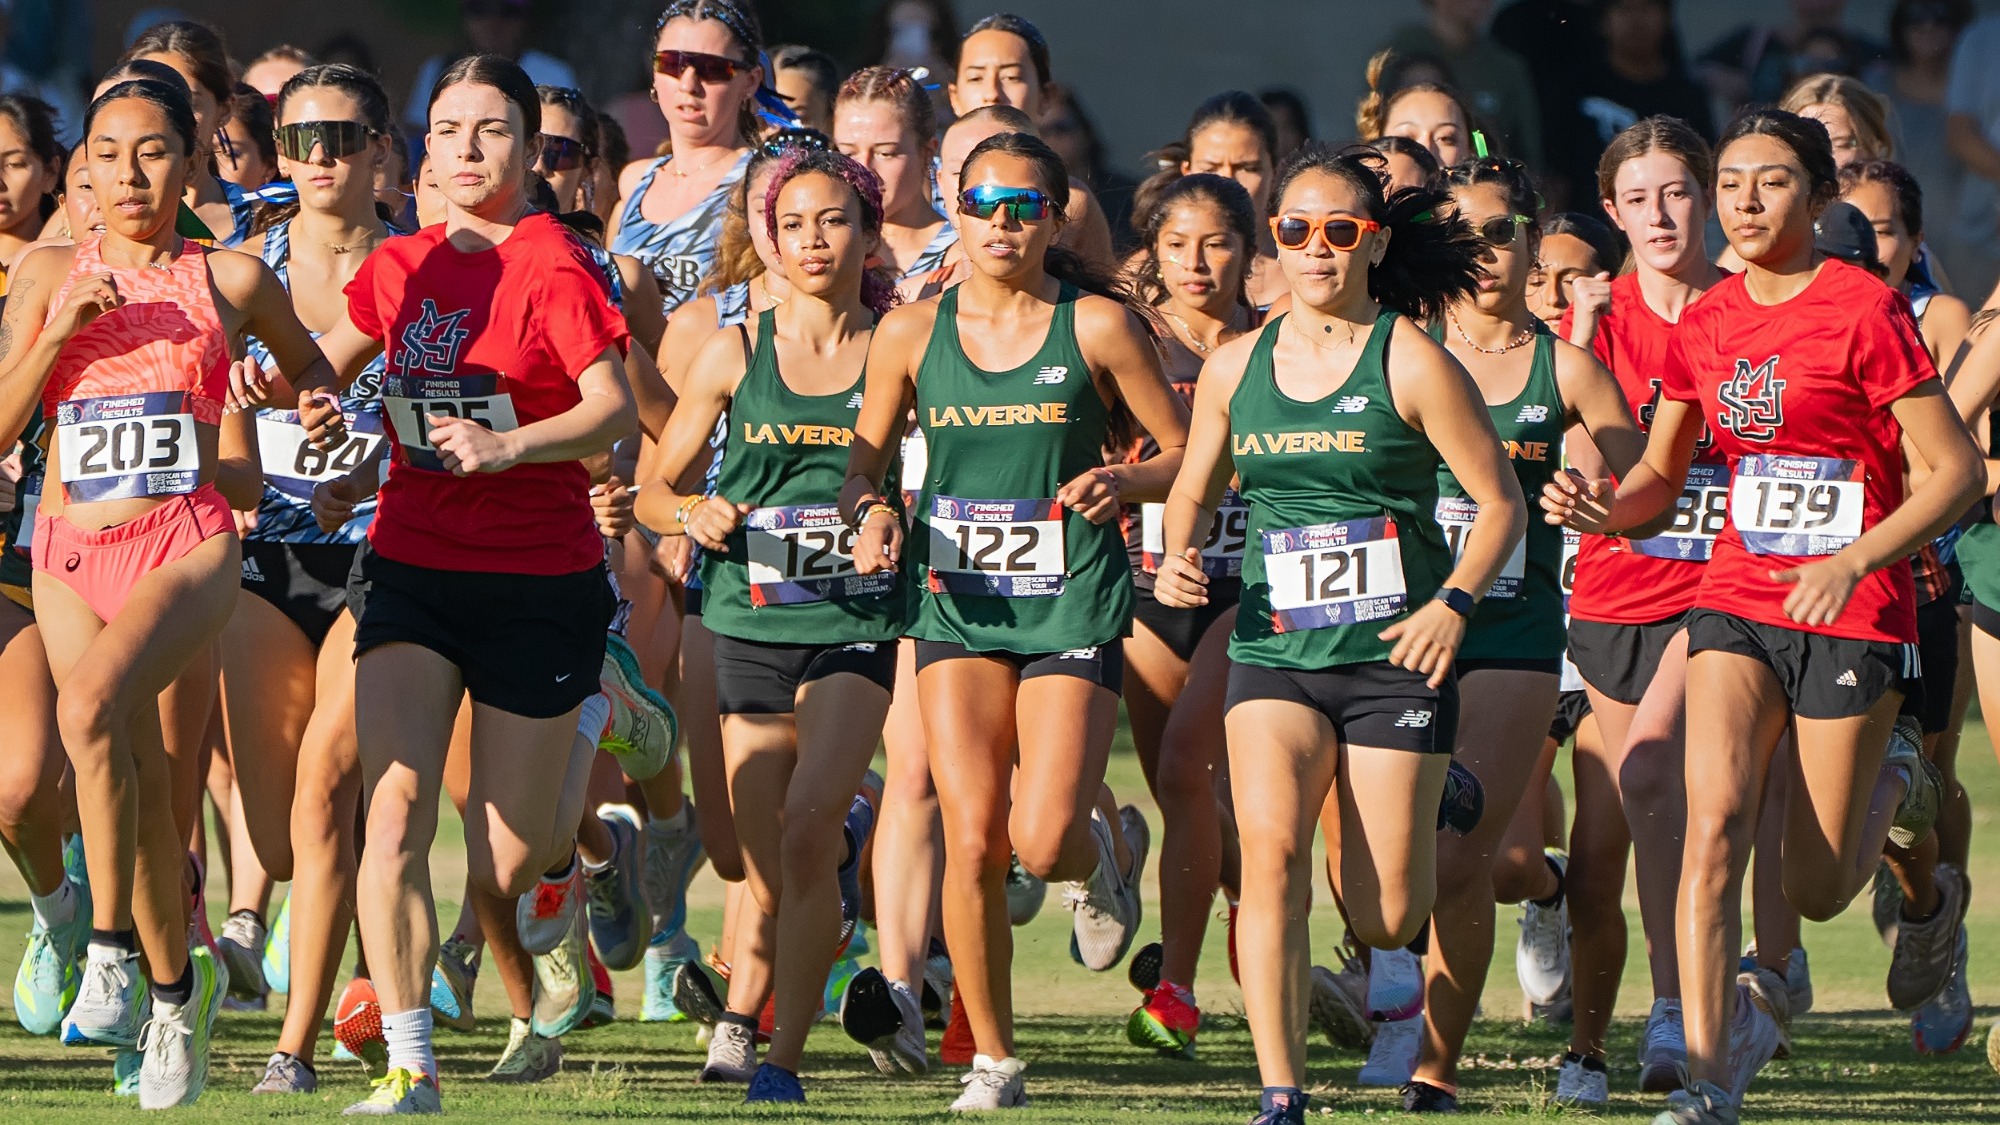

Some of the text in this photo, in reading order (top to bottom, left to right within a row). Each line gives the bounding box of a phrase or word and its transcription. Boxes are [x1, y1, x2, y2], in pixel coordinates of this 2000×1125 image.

[425, 380, 460, 389] FINISHED
[425, 388, 461, 398] RESULTS
[103, 397, 145, 408] FINISHED
[102, 407, 143, 419] RESULTS
[929, 403, 1067, 427] LA VERNE
[744, 423, 855, 448] LA VERN
[79, 418, 182, 475] 203
[1233, 431, 1366, 455] LA VERNE
[294, 437, 368, 476] 64
[1779, 459, 1818, 470] FINISHED
[1688, 467, 1714, 476] ISHED
[1775, 469, 1815, 480] RESULTS
[1685, 476, 1712, 485] SULTS
[974, 503, 1015, 512] FINISHED
[1755, 481, 1841, 529] 139
[802, 516, 842, 527] RESULTS
[972, 513, 1013, 521] RESULTS
[1308, 526, 1348, 539] FINISHED
[955, 524, 1039, 572] 122
[1308, 537, 1347, 549] RESULTS
[781, 529, 857, 578] 129
[1299, 547, 1368, 602] 121
